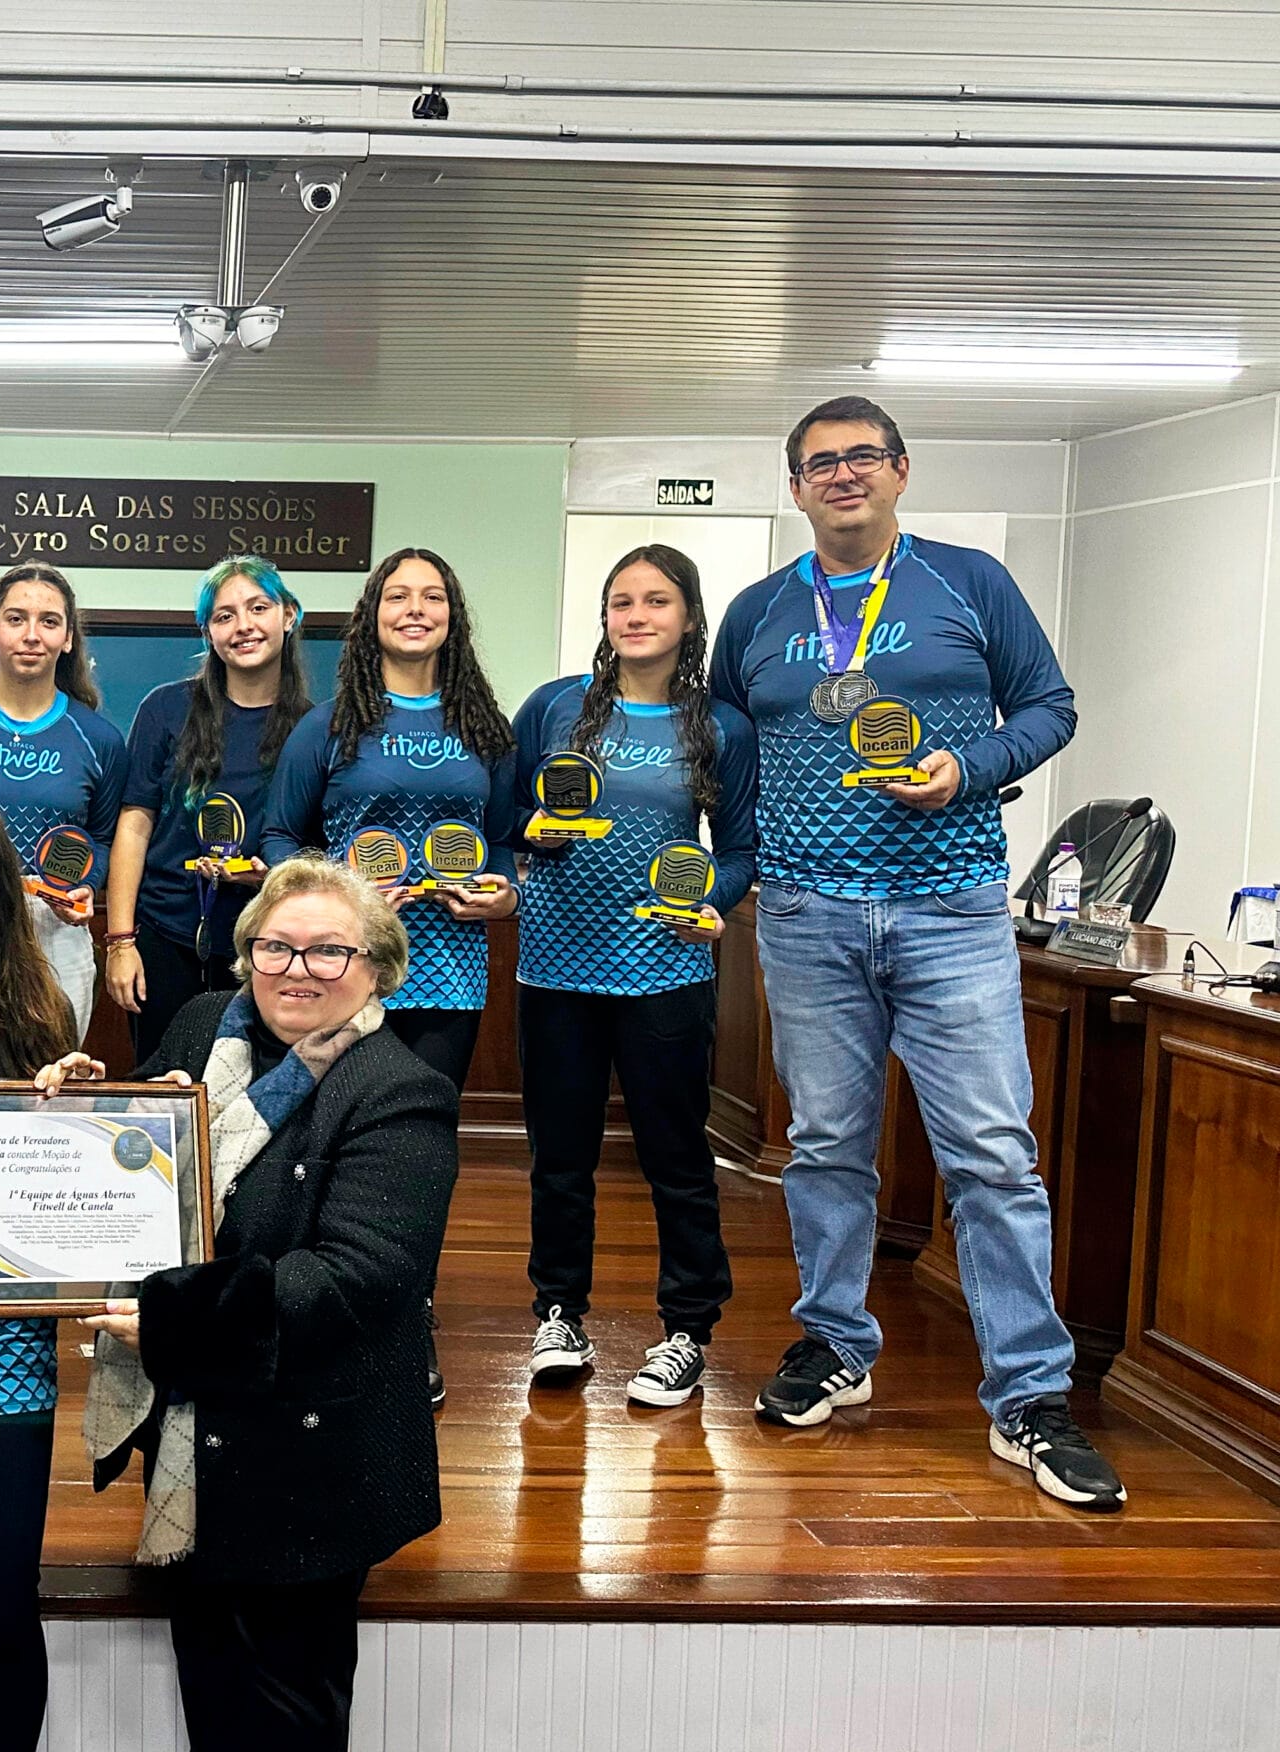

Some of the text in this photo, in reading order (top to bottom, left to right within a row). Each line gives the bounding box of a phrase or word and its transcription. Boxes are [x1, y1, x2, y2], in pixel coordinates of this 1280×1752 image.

[658, 480, 695, 504] SAÍDA
[15, 490, 317, 523] SALA DAS SESSÕES
[89, 524, 207, 554] Soares
[227, 526, 351, 556] Sander
[380, 733, 469, 769] fitwell
[862, 740, 909, 752] ocean
[436, 856, 475, 866] ocean
[46, 860, 81, 880] ocean
[361, 862, 400, 874] ocean
[660, 881, 702, 895] ocean
[9, 1136, 20, 1145] de
[23, 1136, 71, 1145] Vereadores
[7, 1150, 40, 1159] concede
[42, 1149, 71, 1161] Moção
[72, 1150, 82, 1159] de
[9, 1163, 72, 1175] Congratulações
[20, 1189, 54, 1201] Equipe
[56, 1189, 67, 1200] de
[69, 1186, 98, 1201] Águas
[101, 1189, 136, 1200] Abertas
[32, 1201, 114, 1211] Fitwell de Canela
